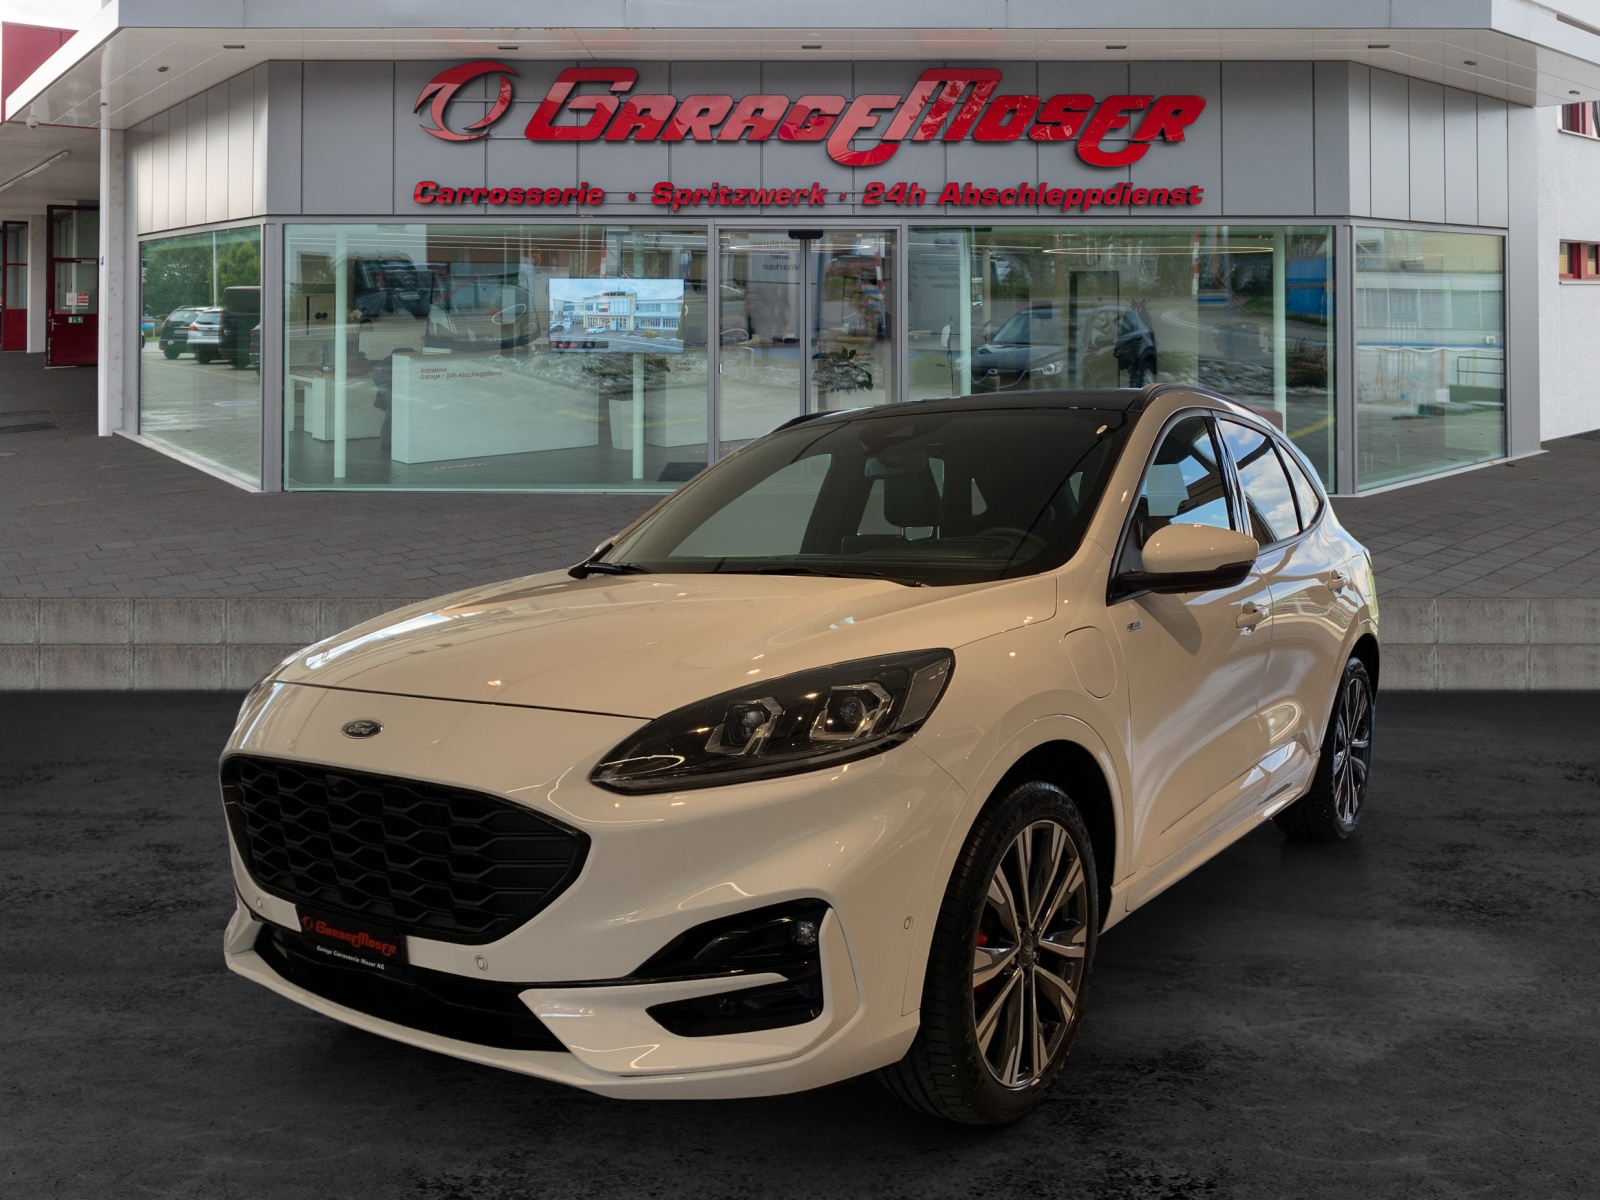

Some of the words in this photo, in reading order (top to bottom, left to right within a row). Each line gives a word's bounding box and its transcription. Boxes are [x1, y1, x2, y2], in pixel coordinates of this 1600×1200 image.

[413, 180, 605, 206] Carrosserie
[651, 181, 827, 212] Spritzwerk
[862, 181, 927, 206] 24h
[937, 181, 1205, 212] Abschleppdienst
[446, 371, 458, 379] 24h
[458, 370, 503, 379] Abschleppdienst
[316, 945, 333, 955] Garage
[333, 950, 360, 963] Carrosserie
[360, 958, 376, 968] Moser
